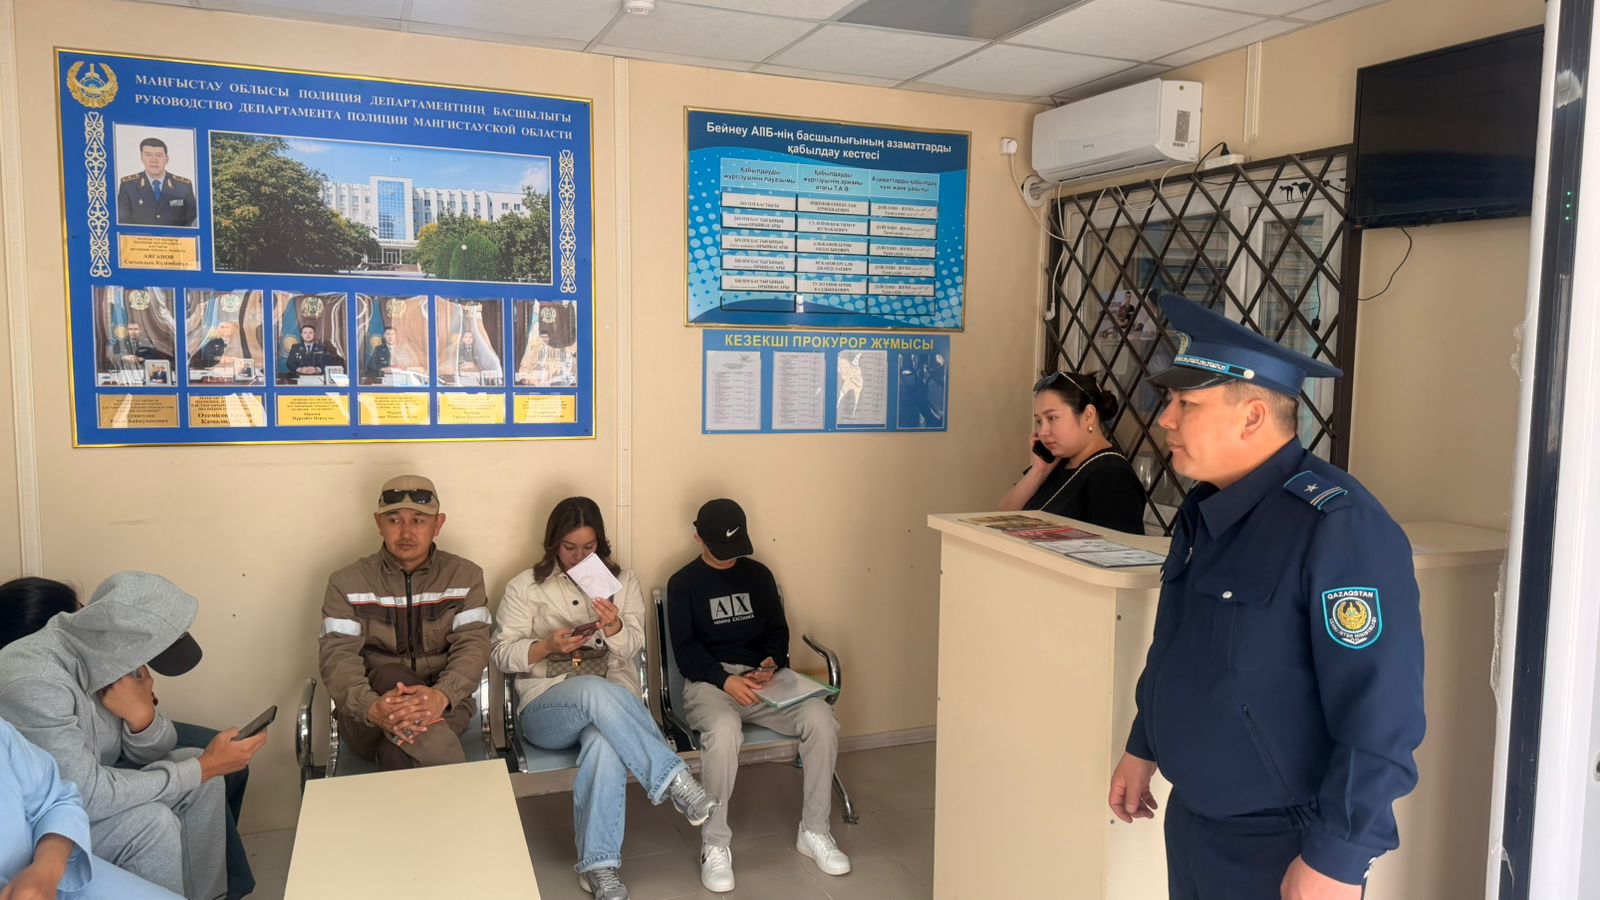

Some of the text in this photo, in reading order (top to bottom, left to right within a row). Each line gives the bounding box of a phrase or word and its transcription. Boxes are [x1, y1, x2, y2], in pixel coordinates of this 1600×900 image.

[135, 74, 572, 123] МАҢҒЫСТАУ ОБЛЫСЫ ПОЛИЦИЯ ДЕПАРТАМЕНТІНІҢ БАСШЫЛЫҒЫ
[135, 94, 573, 141] РУКОВОДСТВО ДЕПАРТАМЕНТА ПОЛИЦИИ МАНГИСТАУСКОЙ ОБЛАСТИ
[706, 121, 748, 138] Бейнеу
[796, 130, 884, 149] басшылығының
[886, 139, 952, 154] азаматтарды
[787, 144, 880, 161] қабылдау кестесі
[724, 334, 934, 350] КЕЗЕКШІ ПРОКУРОР ЖҰМЫСЫ
[1327, 590, 1374, 600] QAZAQSTAN
